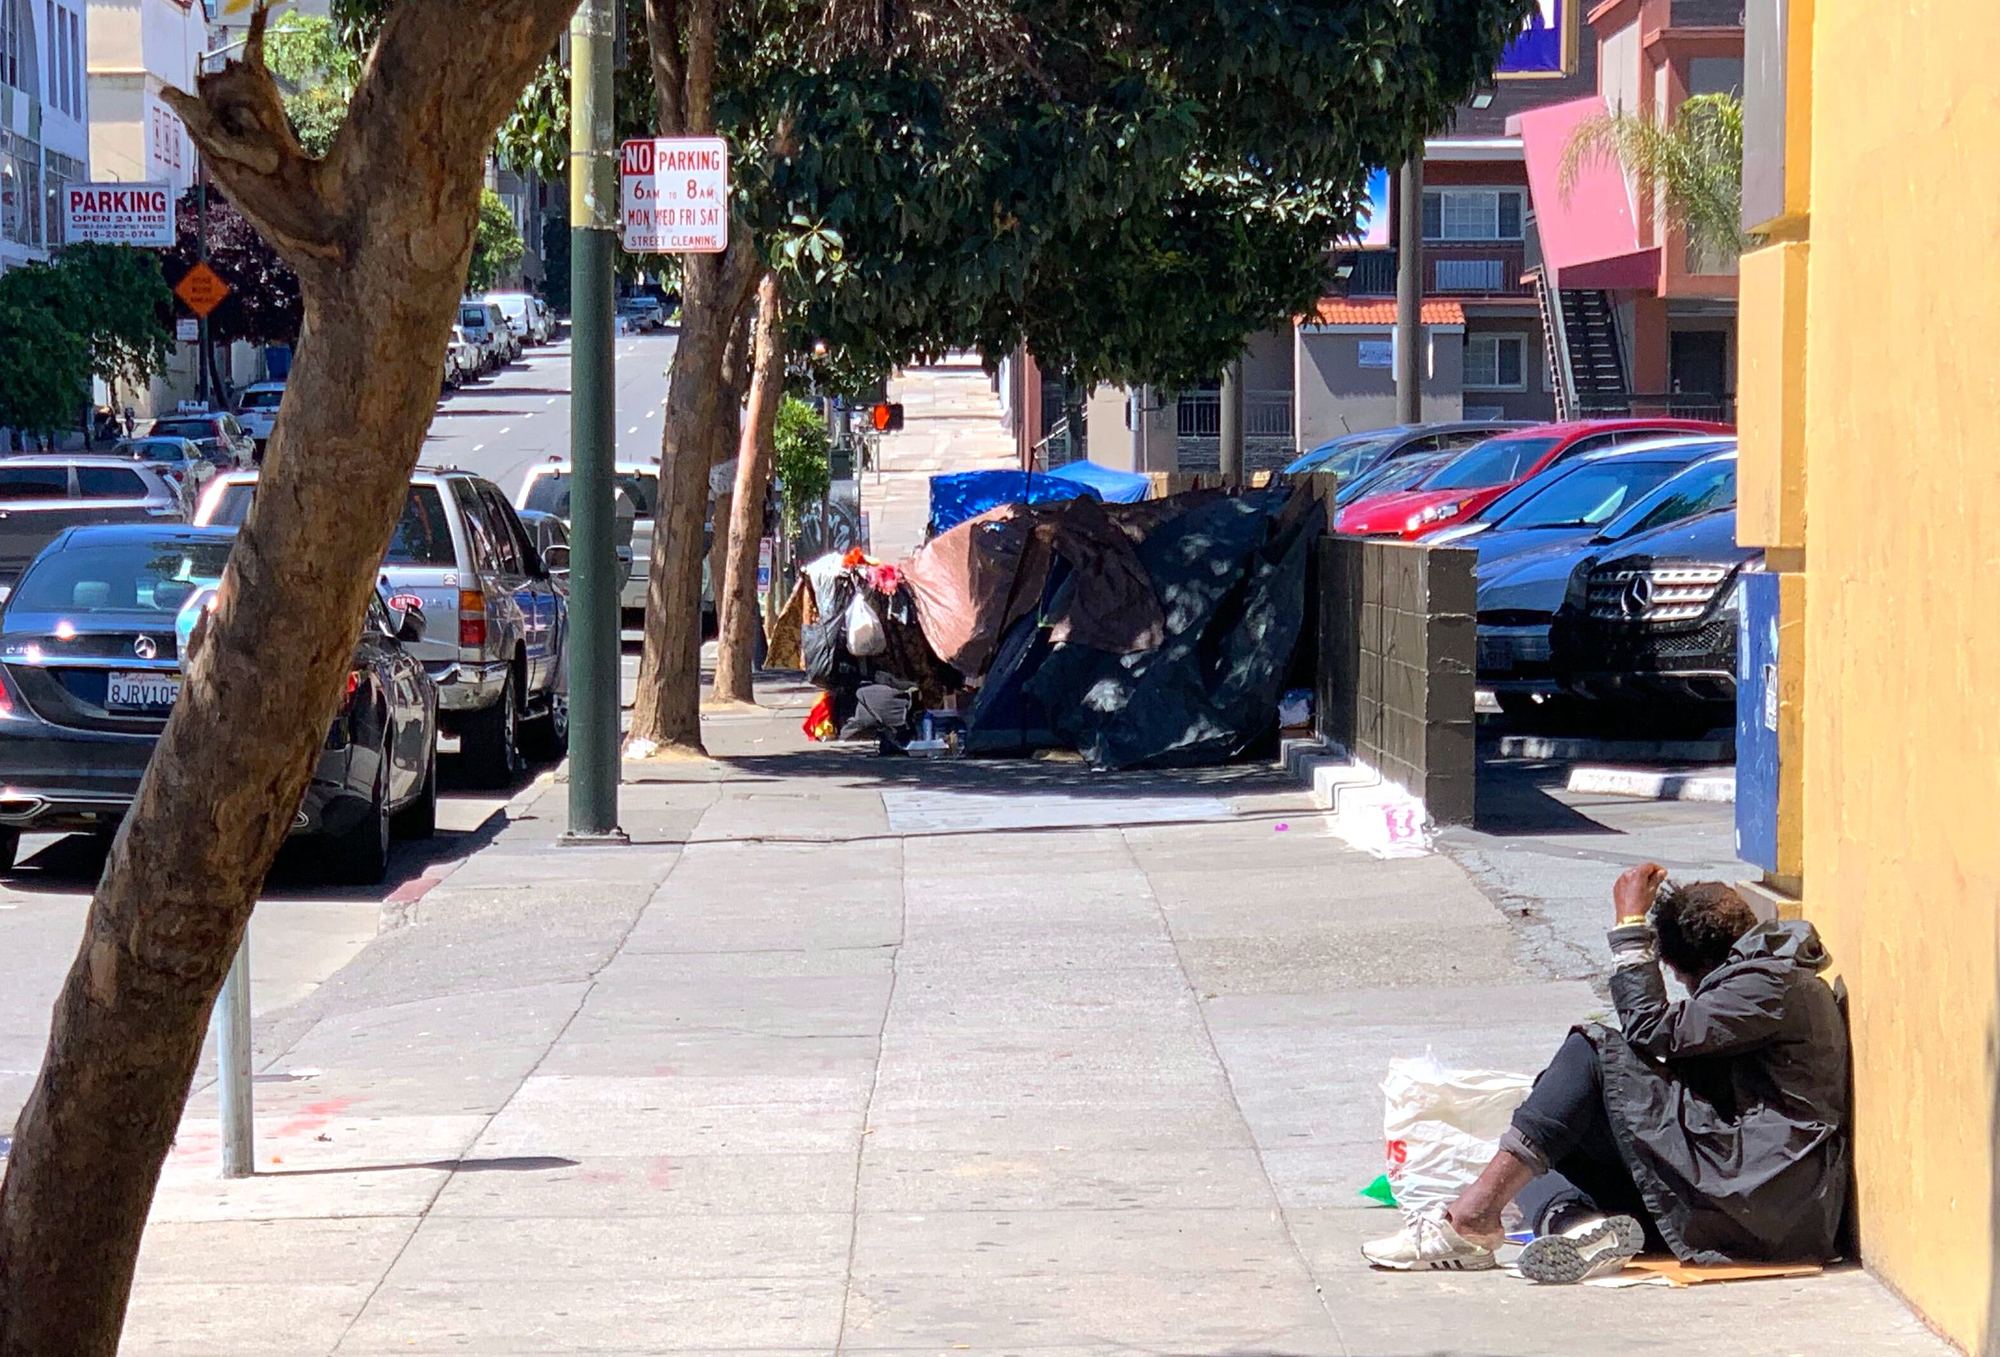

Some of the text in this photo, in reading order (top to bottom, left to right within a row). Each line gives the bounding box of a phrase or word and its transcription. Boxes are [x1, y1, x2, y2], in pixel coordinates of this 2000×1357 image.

[626, 144, 720, 172] NO PARKING
[70, 191, 166, 213] PARKING
[72, 215, 166, 223] OPEN 24 HRS
[628, 208, 719, 226] MON WED FRI SAT
[631, 235, 717, 247] STREET CLEANING
[111, 684, 179, 704] 8JRV105
